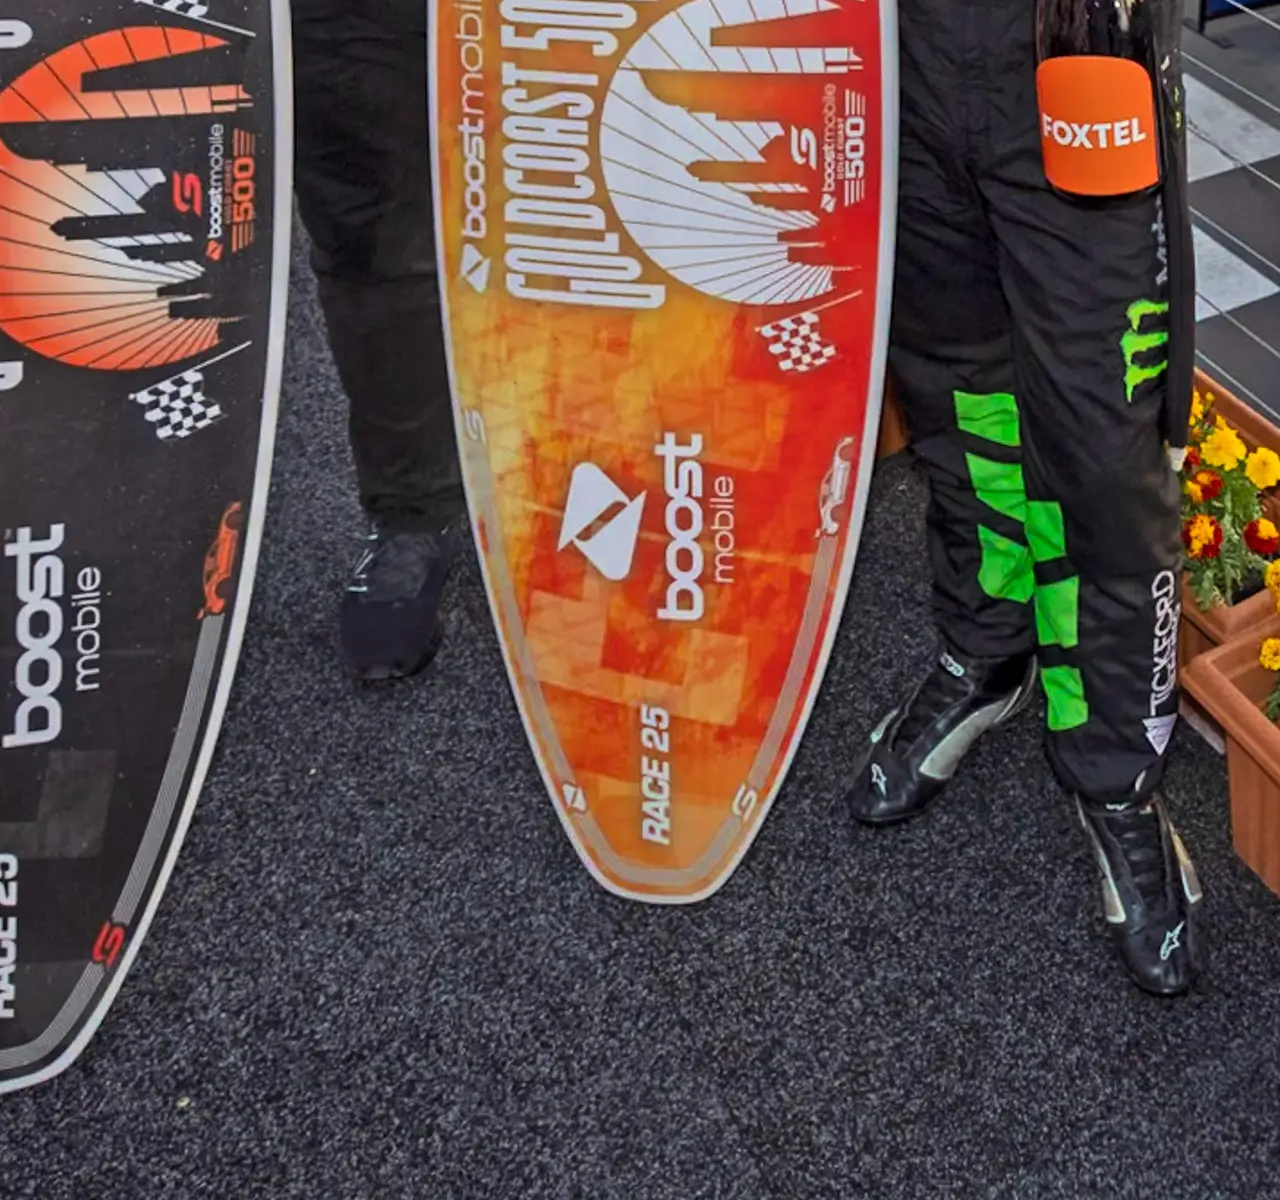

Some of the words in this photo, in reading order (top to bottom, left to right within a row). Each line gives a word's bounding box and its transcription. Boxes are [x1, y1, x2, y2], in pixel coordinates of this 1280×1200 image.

[845, 116, 865, 179] 500
[1041, 113, 1147, 149] FOXTEL
[233, 156, 255, 222] 500
[654, 432, 704, 622] boost
[709, 475, 735, 584] mobile
[3, 523, 66, 749] boost
[72, 566, 101, 692] mobile
[640, 704, 670, 754] 25
[641, 762, 671, 846] RACE
